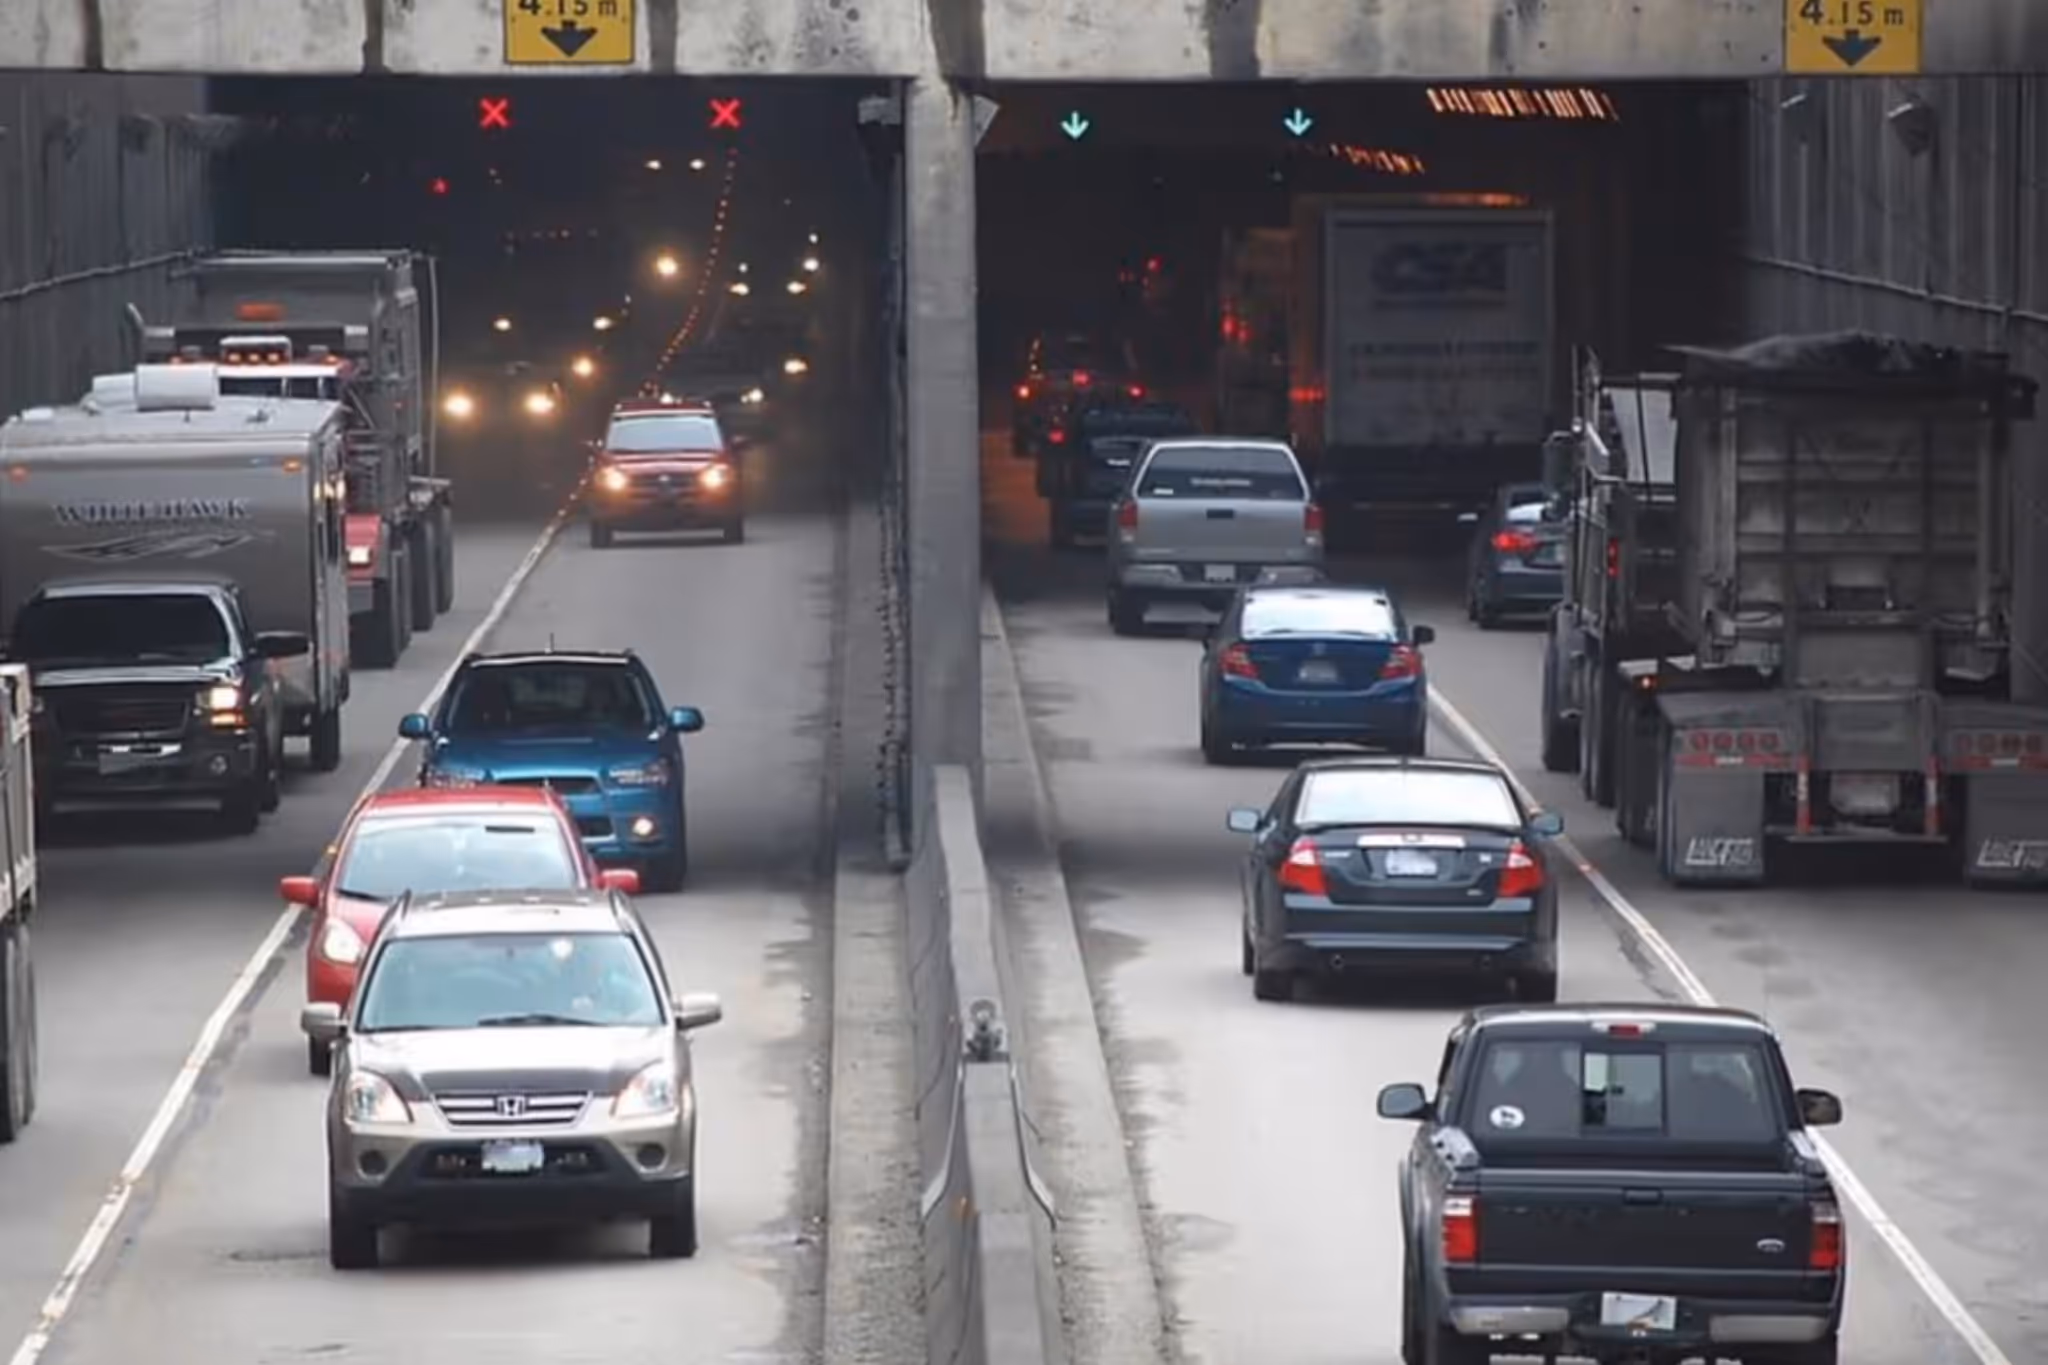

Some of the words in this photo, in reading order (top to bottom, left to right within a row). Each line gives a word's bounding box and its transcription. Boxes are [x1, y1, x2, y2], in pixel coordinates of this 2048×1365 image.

[518, 0, 588, 16] 4.15
[598, 0, 617, 16] m
[1800, 0, 1873, 25] 4.15
[1884, 8, 1903, 25] m
